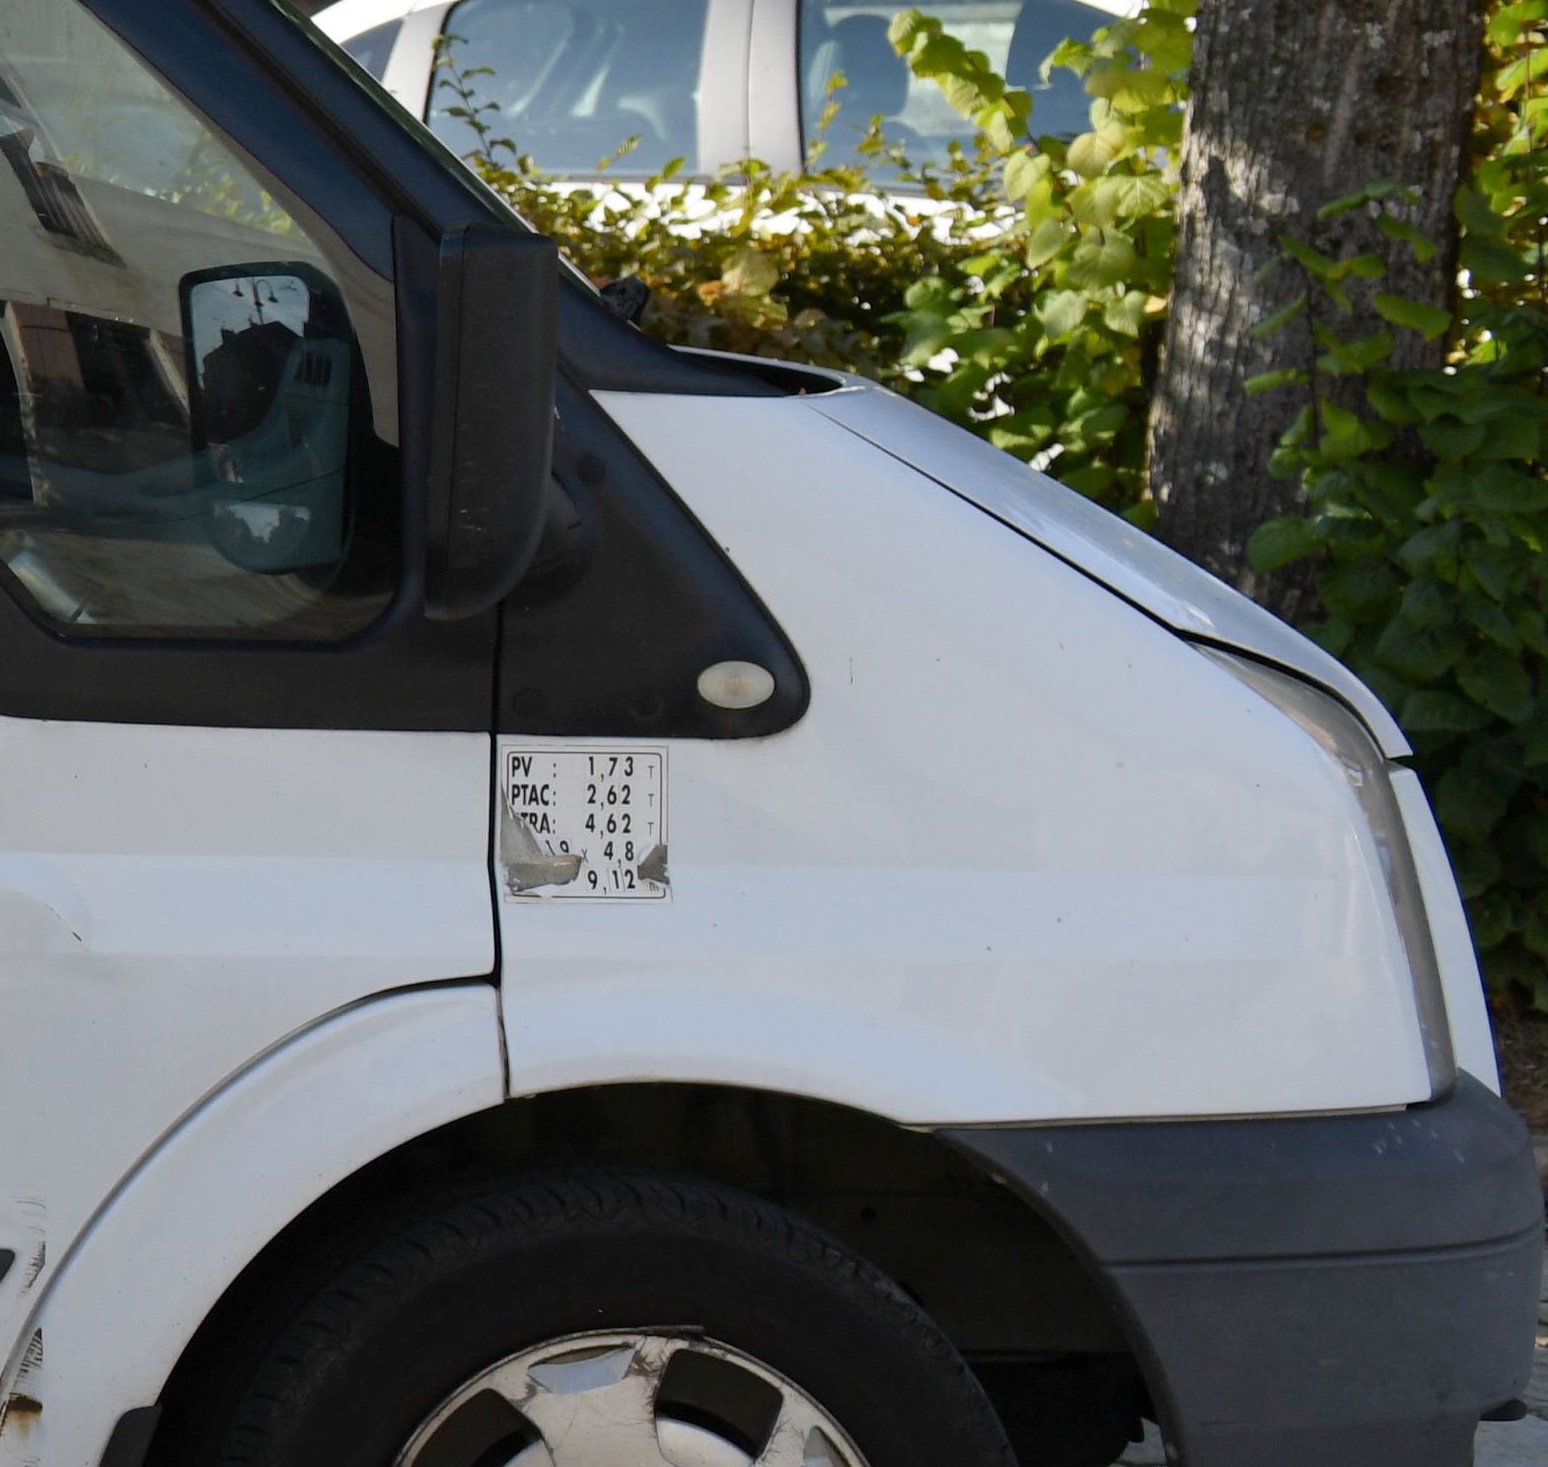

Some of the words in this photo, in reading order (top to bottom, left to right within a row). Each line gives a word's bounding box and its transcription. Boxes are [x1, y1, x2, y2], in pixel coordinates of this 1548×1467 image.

[511, 756, 533, 777] PV
[588, 756, 634, 782] 1,73
[587, 784, 631, 810] 2,62
[585, 813, 632, 839] 4,62
[603, 841, 635, 867] 4,8
[587, 869, 636, 895] 9,12
